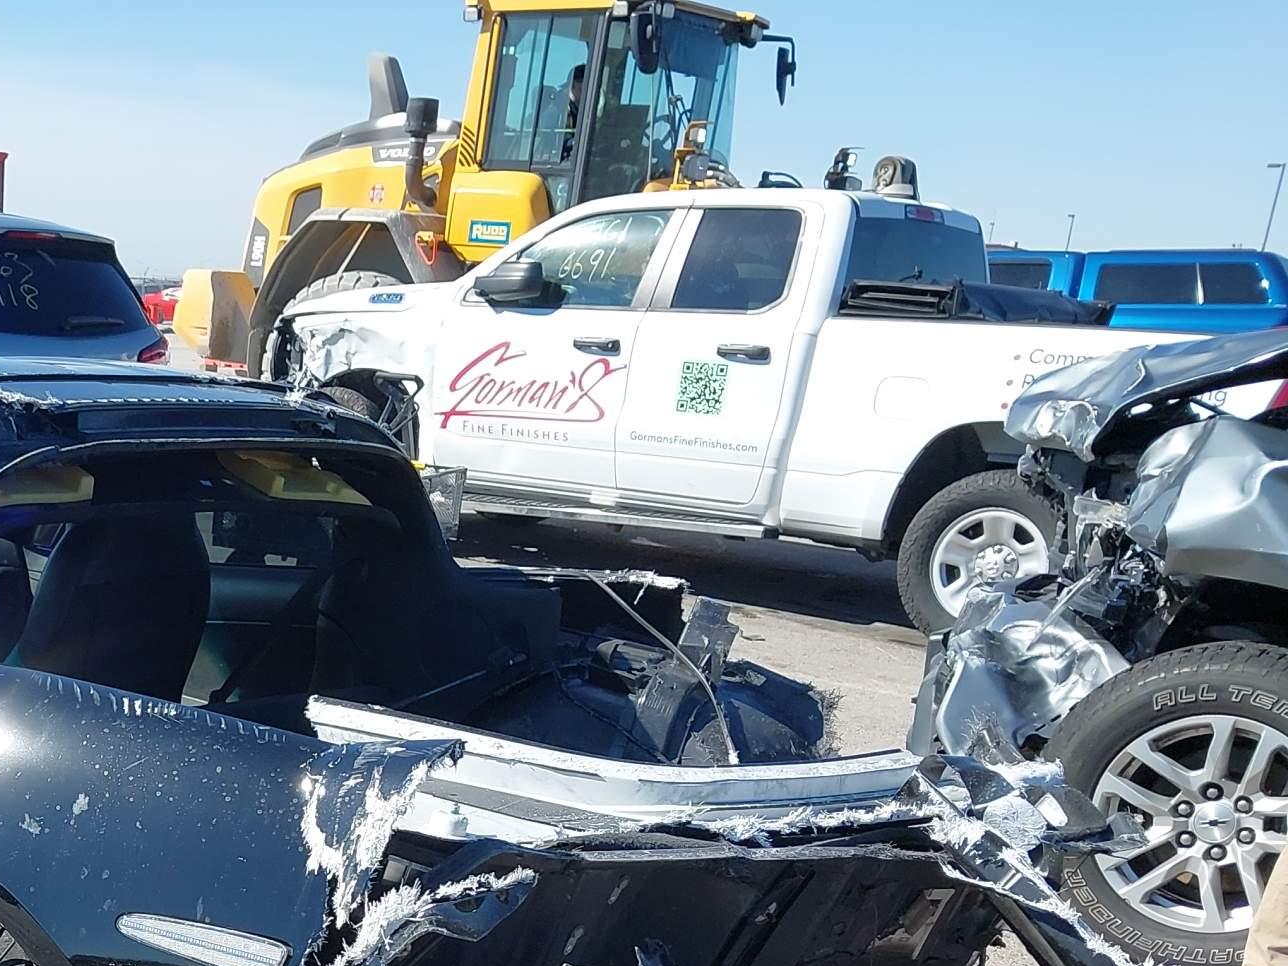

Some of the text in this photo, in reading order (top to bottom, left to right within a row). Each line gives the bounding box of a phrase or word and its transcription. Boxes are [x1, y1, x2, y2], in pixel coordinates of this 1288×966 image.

[379, 147, 436, 159] VOLO
[472, 223, 508, 240] RUDD
[462, 420, 569, 442] FINE FINISHES
[629, 430, 759, 453] GormansFineFinishes.com
[1153, 683, 1217, 711] ALL
